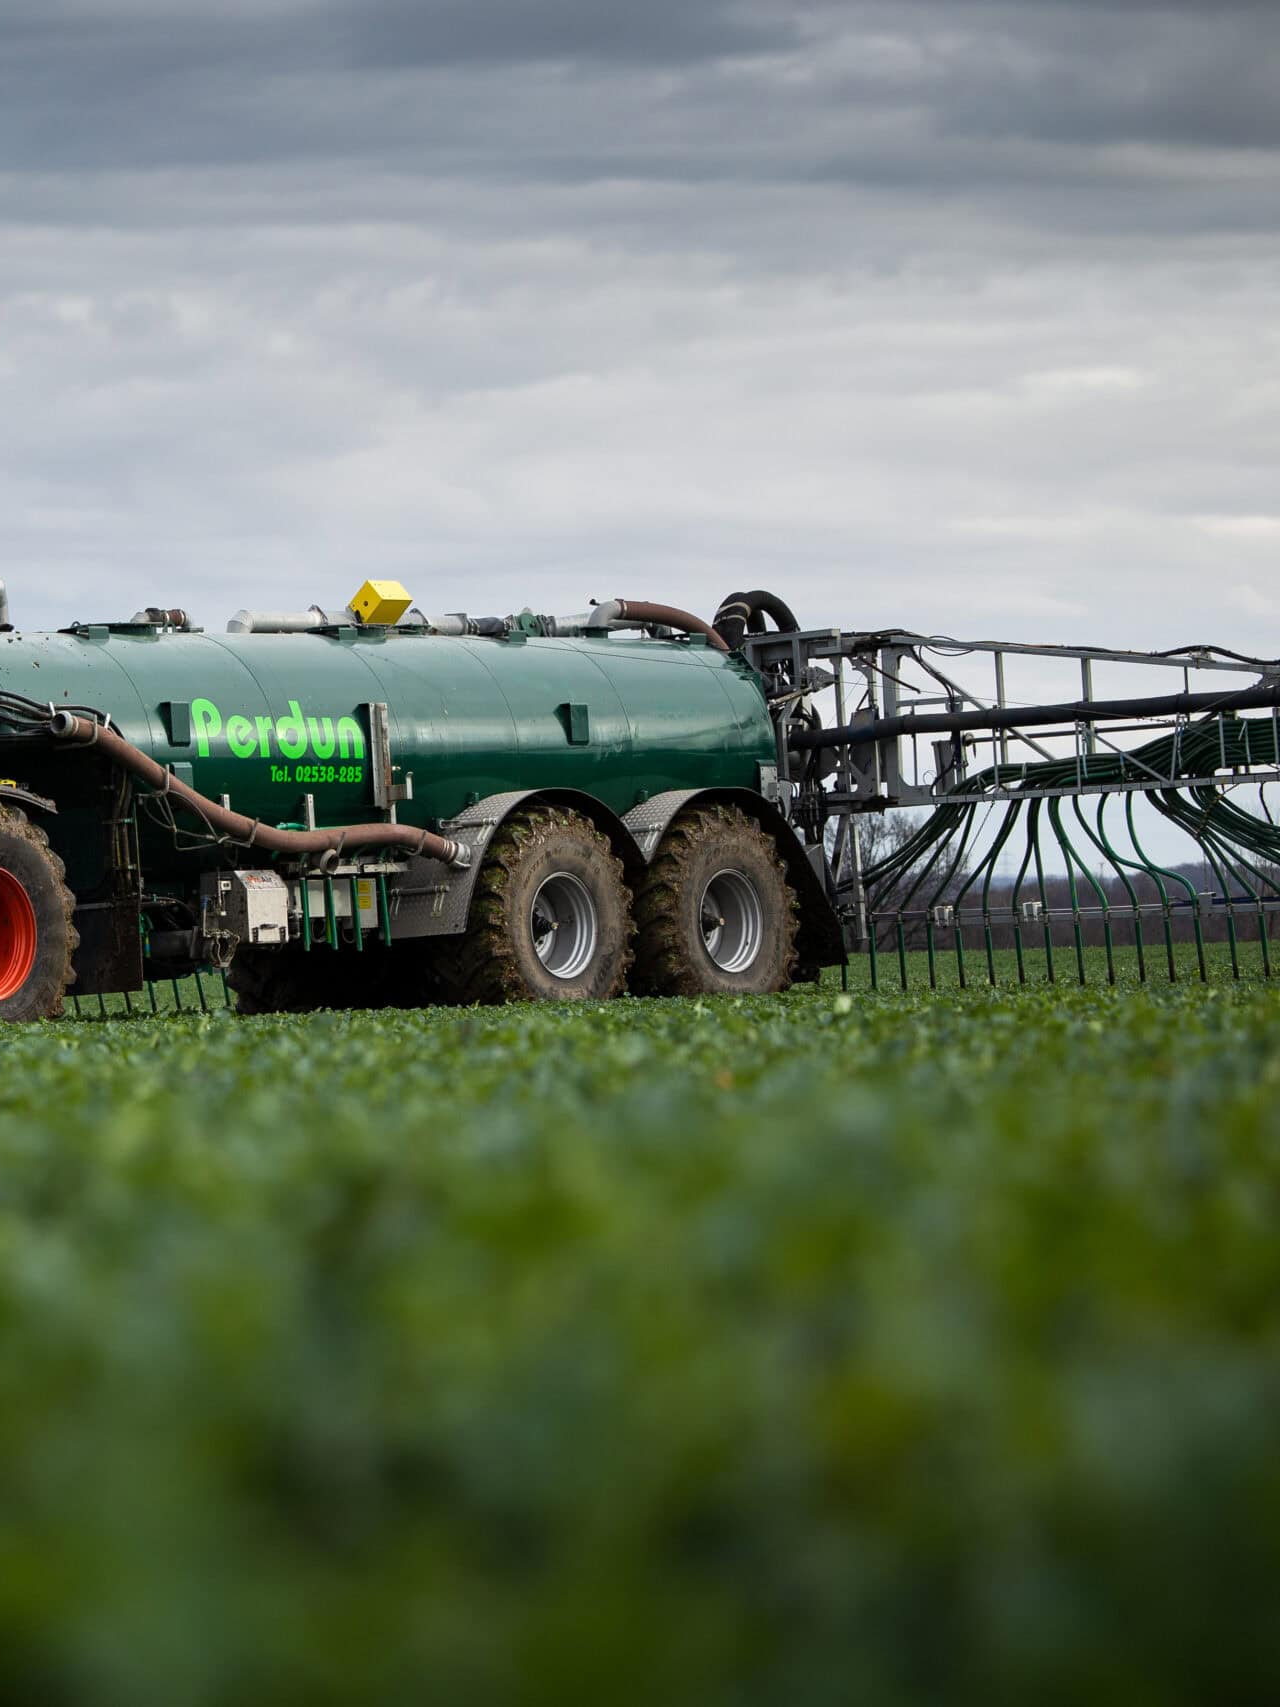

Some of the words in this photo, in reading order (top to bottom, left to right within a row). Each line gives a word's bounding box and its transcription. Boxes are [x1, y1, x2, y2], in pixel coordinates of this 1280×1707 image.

[192, 698, 364, 759] Perdun
[270, 765, 292, 782] Tel.
[295, 765, 363, 783] 02538-285
